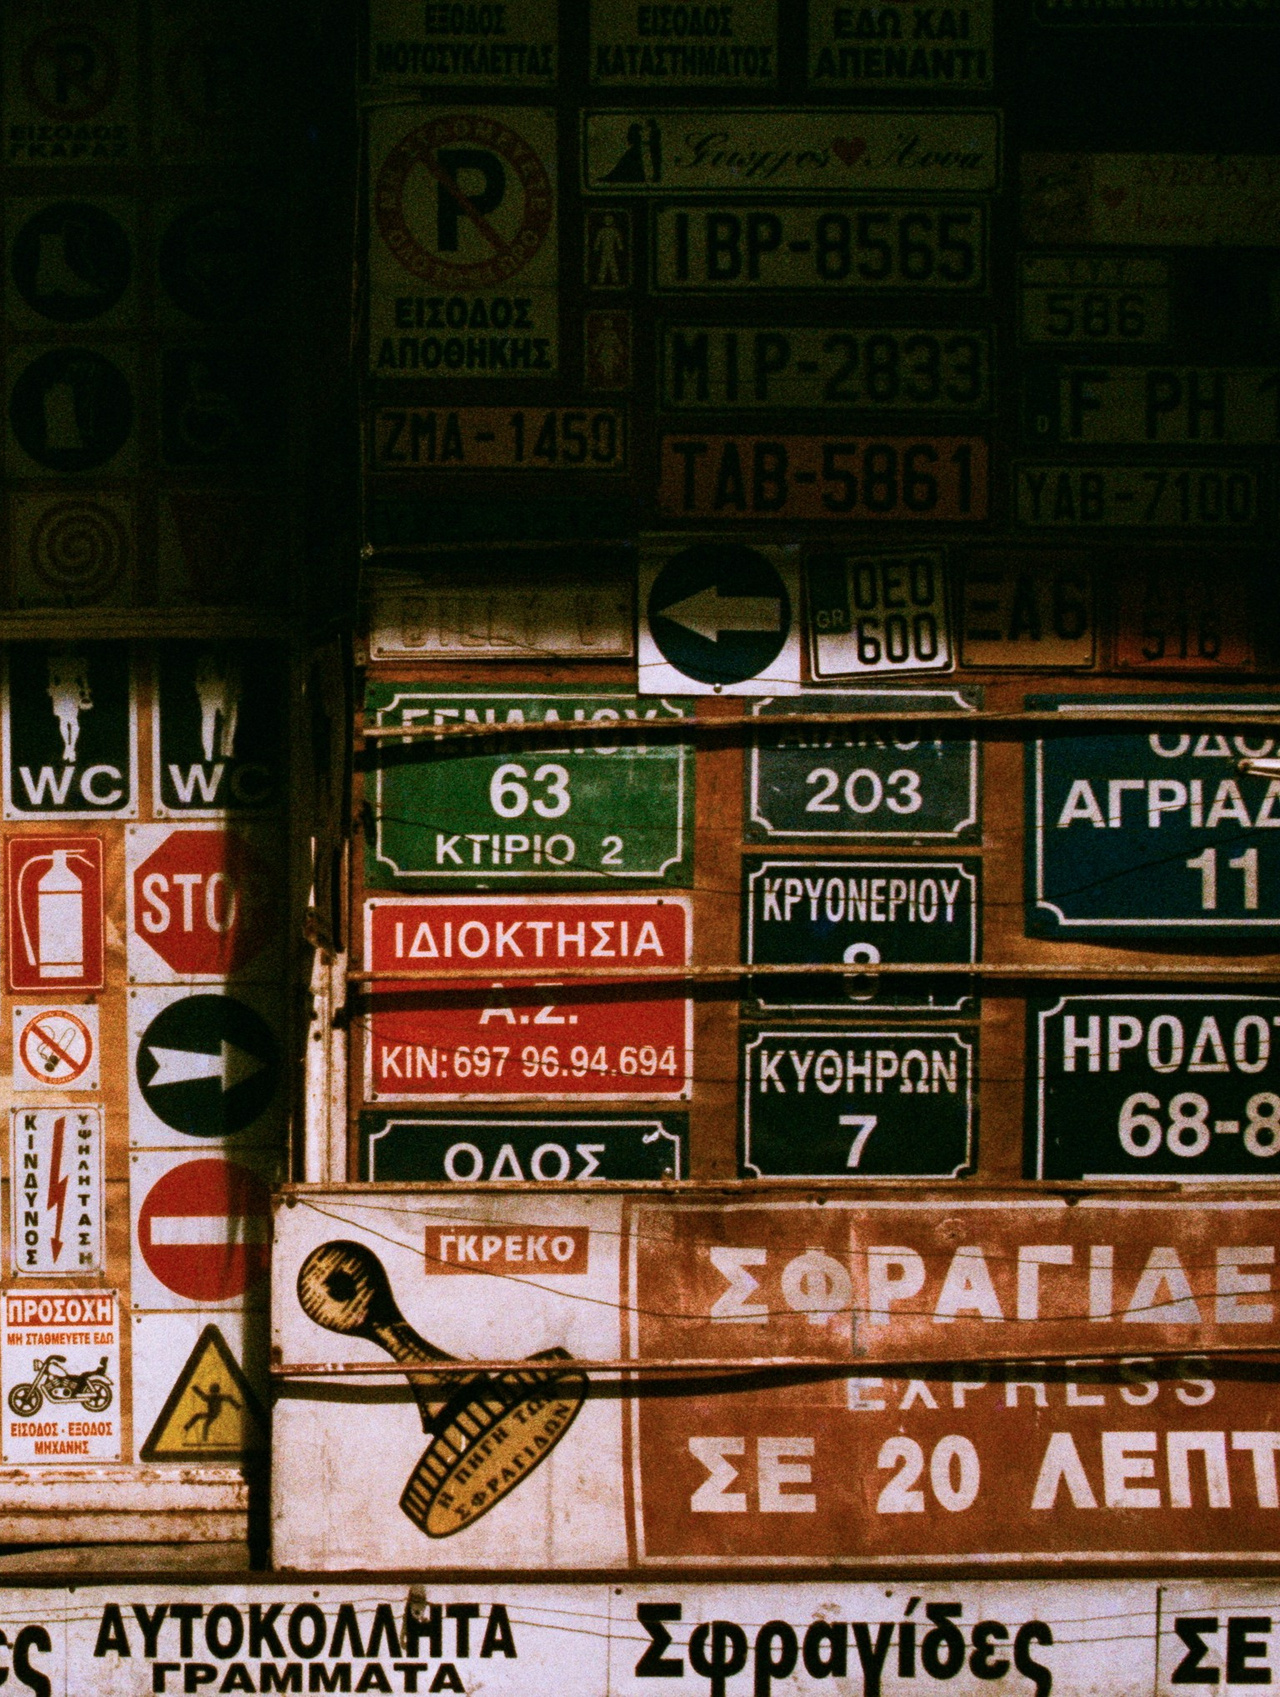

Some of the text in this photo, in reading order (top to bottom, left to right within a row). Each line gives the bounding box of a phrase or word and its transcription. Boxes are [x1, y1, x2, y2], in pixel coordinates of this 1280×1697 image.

[833, 8, 970, 39] ΕΔΩ ΚΑΙ
[816, 48, 987, 79] ΑΠΕΝΑΝΤΙ
[395, 297, 533, 330] ΕΙΣΟΔΟΣ
[1047, 292, 1145, 337] 586
[378, 337, 552, 370] ΑΠΟΘΗΚΗΣ
[857, 611, 938, 664] 600
[19, 764, 122, 805] WC
[489, 764, 571, 819] 63
[805, 768, 923, 814] 203
[435, 834, 623, 865] ΚΤΙΡΙΟ 2
[763, 877, 961, 923] ΚΡΥΟΝΕΡΙΟΥ
[1186, 848, 1258, 910] 11
[142, 872, 240, 933] STO
[394, 920, 665, 959] ΙΔΙΟΚΤΗΣΙΑ
[381, 1045, 677, 1078] ΚΙΝ: 697 96.94.694
[1063, 1014, 1280, 1073] ΗΡΟΔΟ
[759, 1050, 958, 1094] ΚΥΘΗΡΩΝ
[444, 1142, 606, 1181] ΟΔΟΣ
[838, 1115, 878, 1168] 7
[439, 1235, 577, 1264] ΓΚΡΕΚΟ
[708, 1245, 1276, 1325] ΣΦΡΑΓΙΔΕ
[8, 1299, 111, 1323] ΠΡΟΣΟΧΗ
[10, 1421, 113, 1437] ΕΙΣΟΔΟΣ ΕΞΟΔΟΣ
[688, 1436, 817, 1512] ΣΕ
[876, 1432, 982, 1515] 20
[93, 1603, 518, 1660] ΑΥΤΟΚΟΛΛΗΤΑ
[635, 1596, 1053, 1697] Σφραγίδες
[1171, 1616, 1273, 1685] ΣΕ
[152, 1662, 466, 1695] ΓΡΑΜΜΑΤΑ
